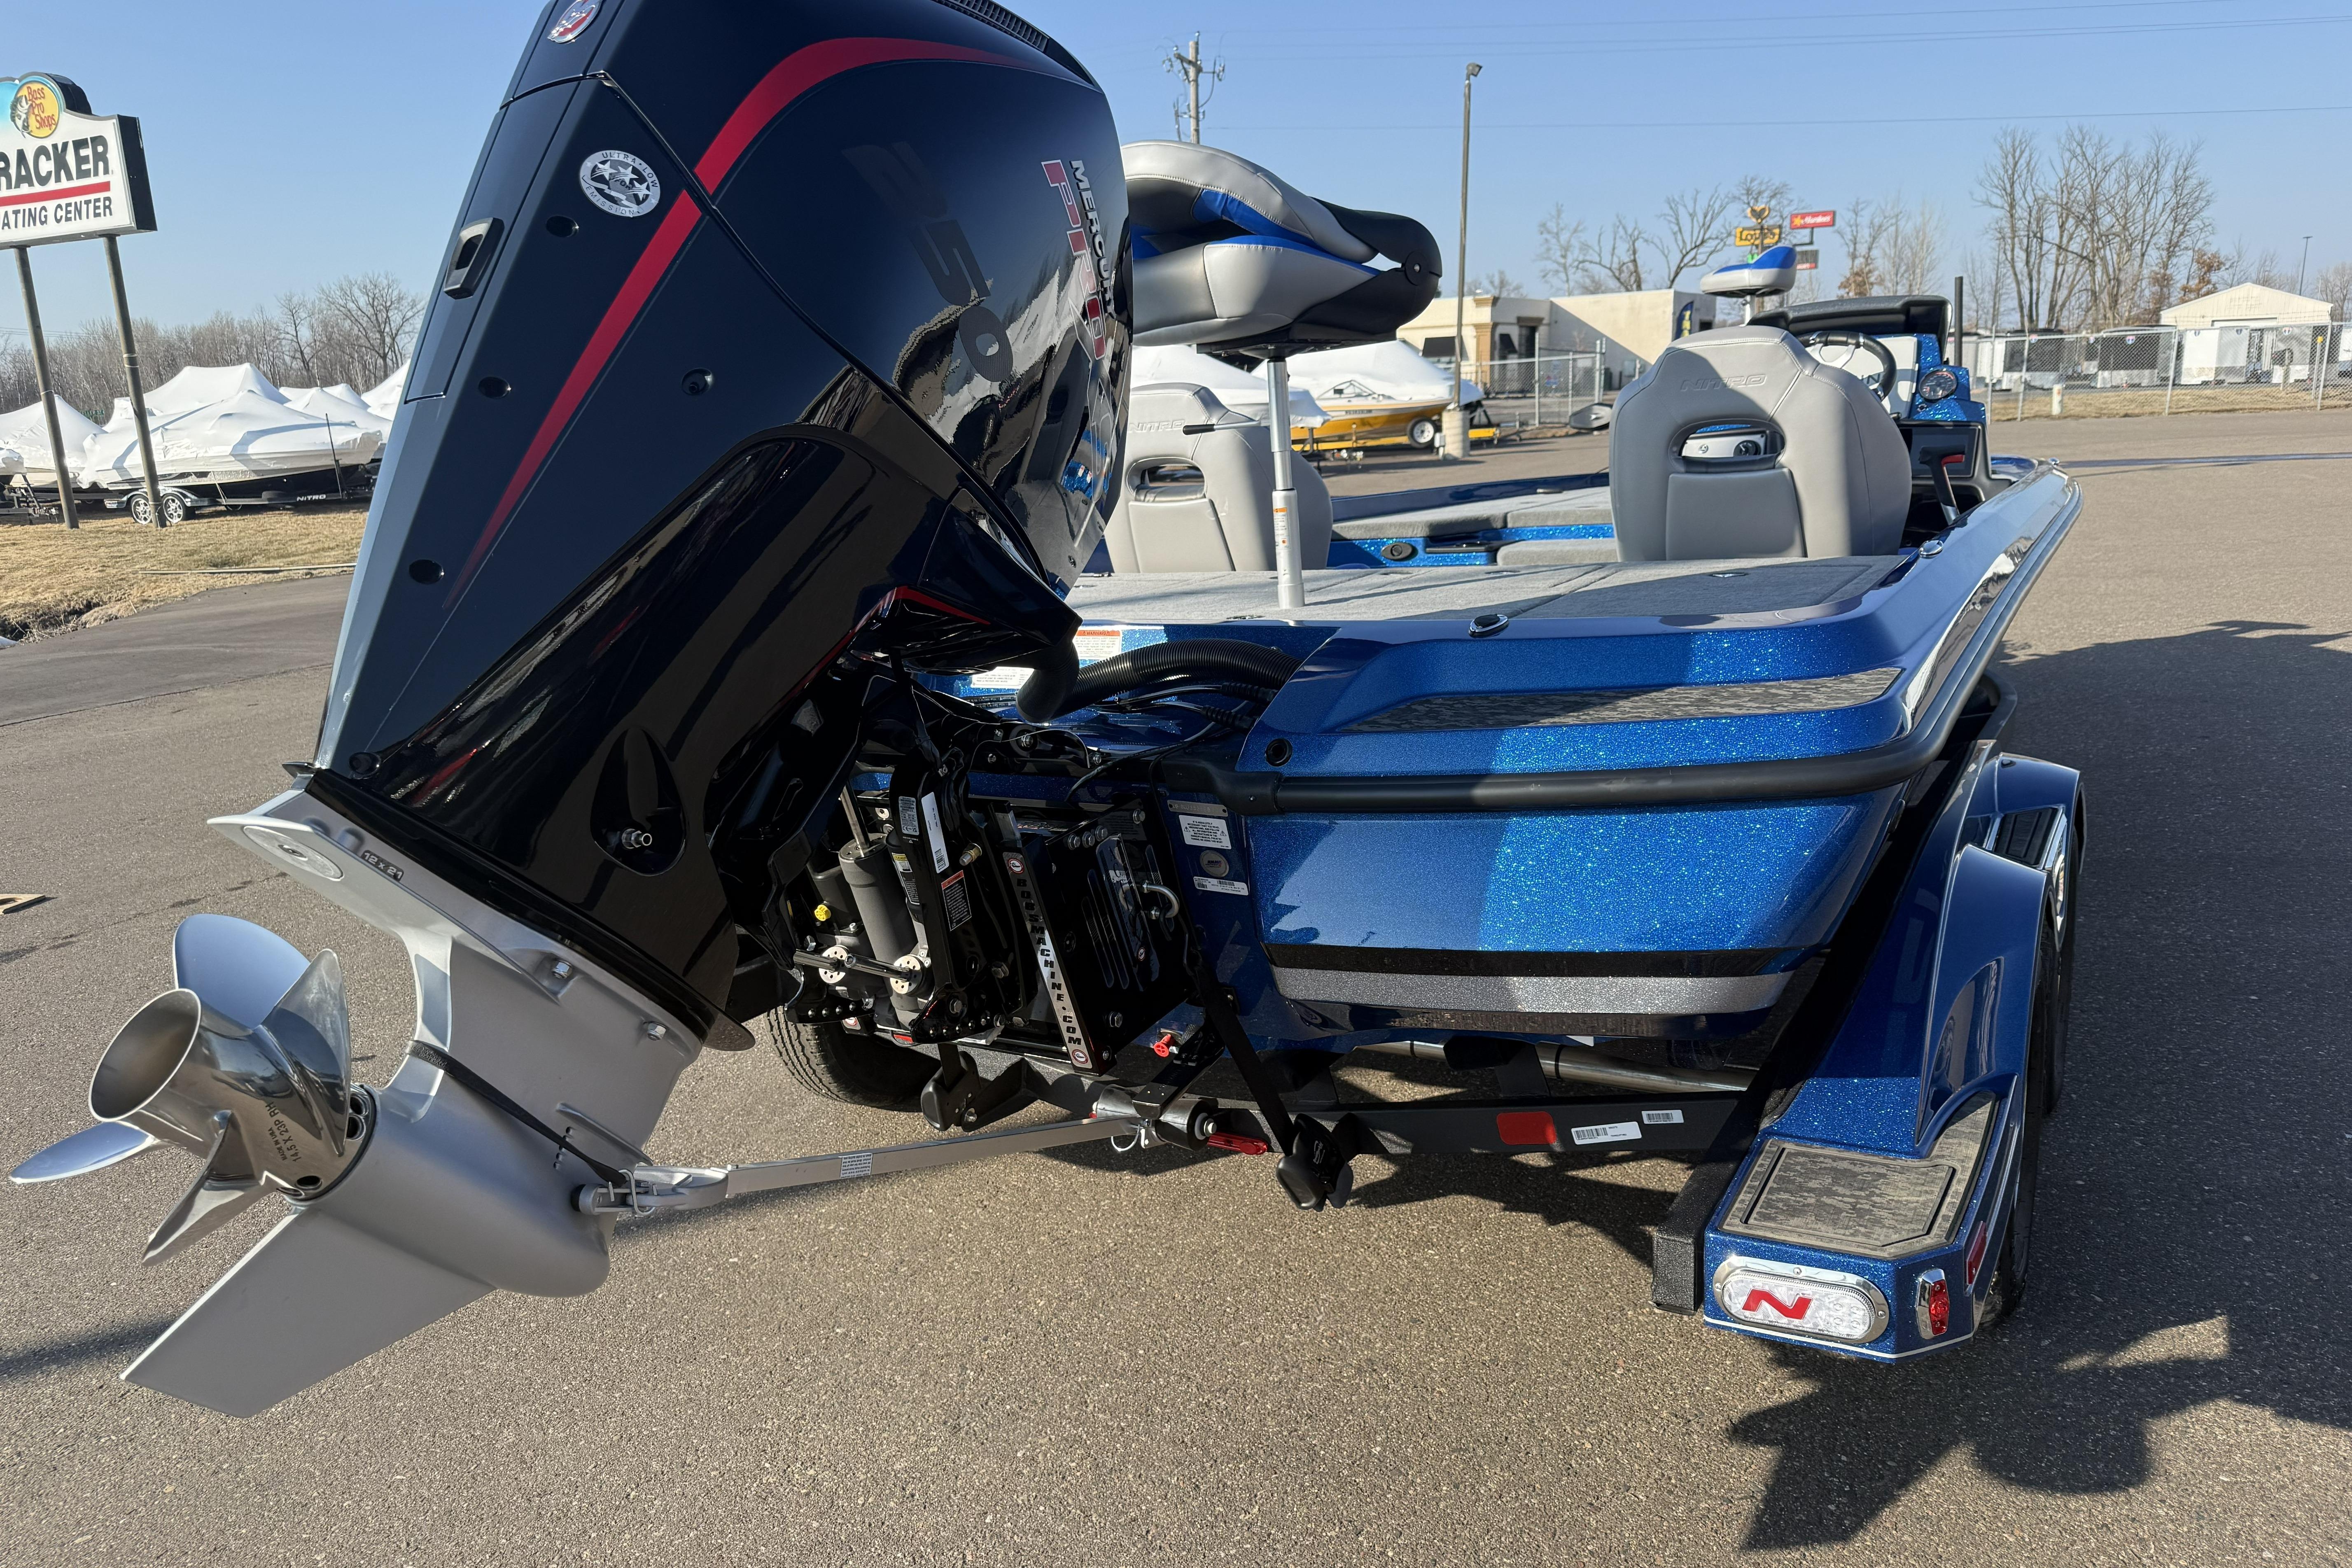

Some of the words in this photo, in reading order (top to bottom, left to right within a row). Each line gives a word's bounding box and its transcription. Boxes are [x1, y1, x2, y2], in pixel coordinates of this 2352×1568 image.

[26, 86, 45, 101] Bass
[31, 100, 44, 115] Pro
[35, 114, 56, 131] Shops
[602, 152, 637, 164] ULTRA
[643, 167, 658, 187] LOW
[54, 196, 112, 224] CENTER
[1069, 160, 1117, 320] MERCURY
[1680, 374, 1767, 392] NITRO
[1128, 419, 1185, 433] NITRO
[586, 597, 635, 627] EMISSION
[364, 853, 378, 865] 12
[387, 866, 403, 879] 21
[1017, 878, 1081, 1045] BOBSMACHINE.COM
[265, 1101, 280, 1118] RH
[268, 1127, 277, 1139] USA
[274, 1119, 289, 1136] 23P
[277, 1146, 287, 1161] MADE
[287, 1144, 301, 1162] 14.5
